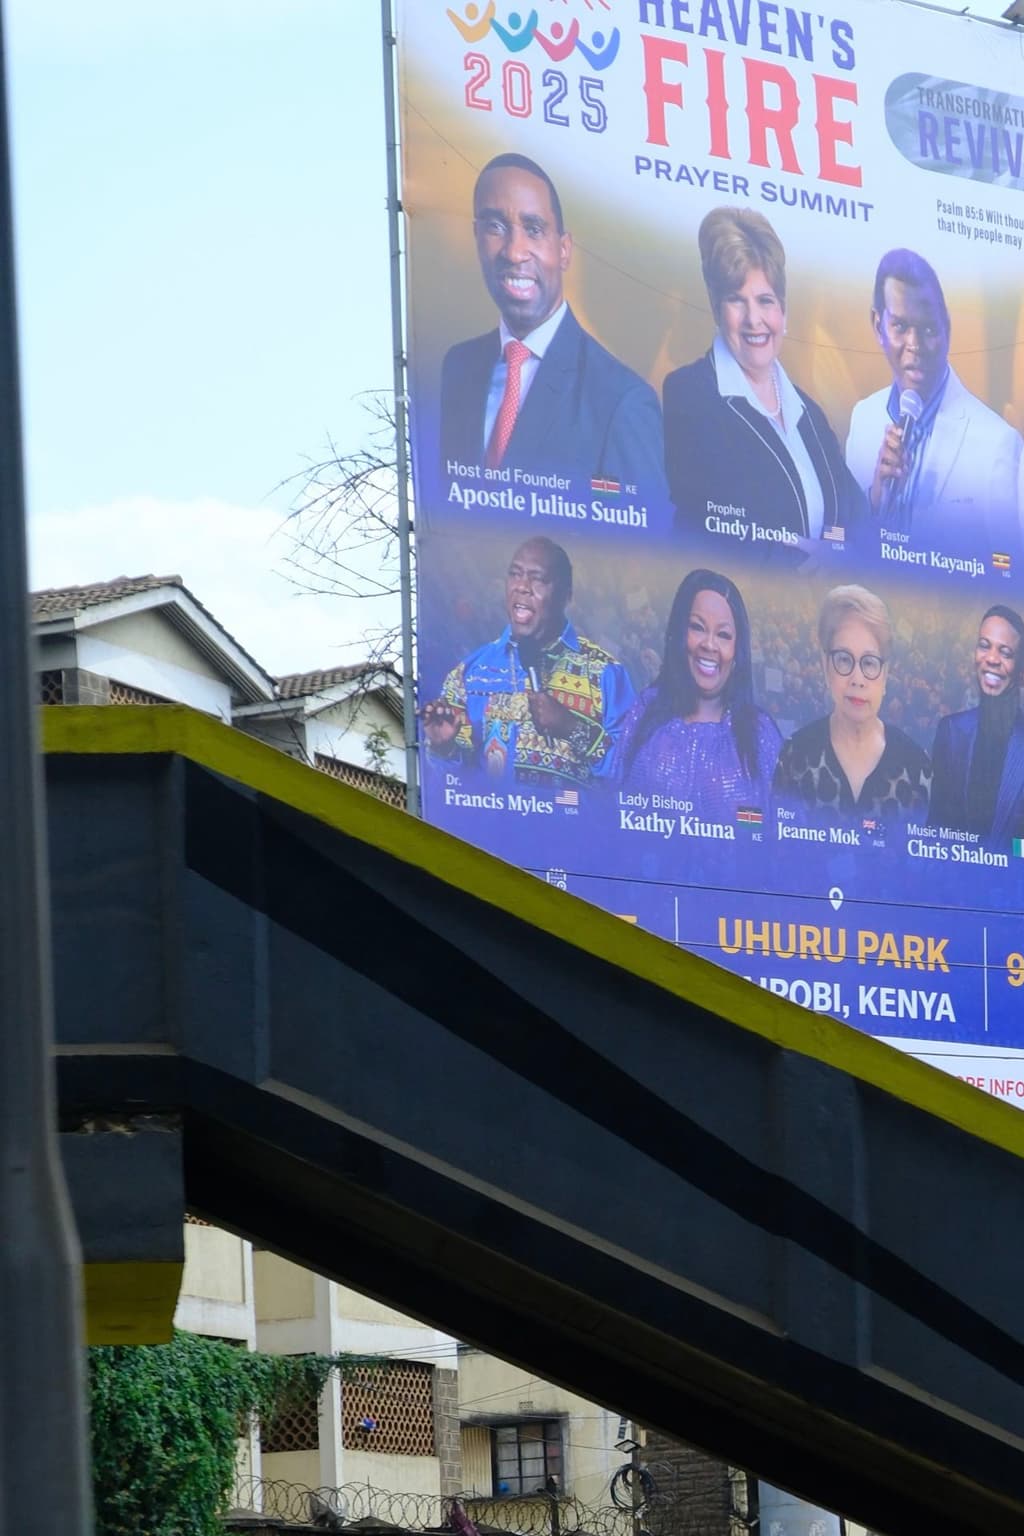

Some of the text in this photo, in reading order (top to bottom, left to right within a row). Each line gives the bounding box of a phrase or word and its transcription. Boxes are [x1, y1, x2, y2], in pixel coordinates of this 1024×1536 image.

[463, 51, 608, 134] 2025
[640, 33, 863, 188] FIRE
[634, 155, 875, 222] PRAYER SUMMIT
[936, 199, 964, 217] Psalm
[965, 206, 984, 222] 85:6
[985, 209, 1003, 226] Wilt
[1004, 213, 1024, 230] thou
[937, 217, 956, 233] that
[957, 222, 972, 239] thy
[973, 228, 1003, 245] people
[1004, 234, 1023, 251] may
[447, 460, 571, 491] Host and Founder
[625, 484, 638, 495] KE
[447, 481, 648, 528] Apostle Julius Suubi
[706, 500, 746, 518] Prophet
[704, 515, 799, 545] Cindy Jacobs
[880, 528, 910, 543] Pastor
[880, 543, 986, 577] Robert Kayanja
[445, 773, 462, 787] Dr.
[444, 788, 554, 817] Francis Myles
[564, 806, 579, 816] USA
[618, 791, 694, 814] Lady Bishop
[776, 807, 796, 820] Rev
[619, 809, 736, 841] Kathy Kiuna
[751, 833, 763, 843] KE
[776, 821, 861, 847] Jeanne Mok
[906, 823, 981, 844] Music Minister
[906, 838, 1009, 868] Chris Shalom
[717, 917, 951, 973] UHURU PARK
[743, 976, 957, 1023] ROBI, KENYA
